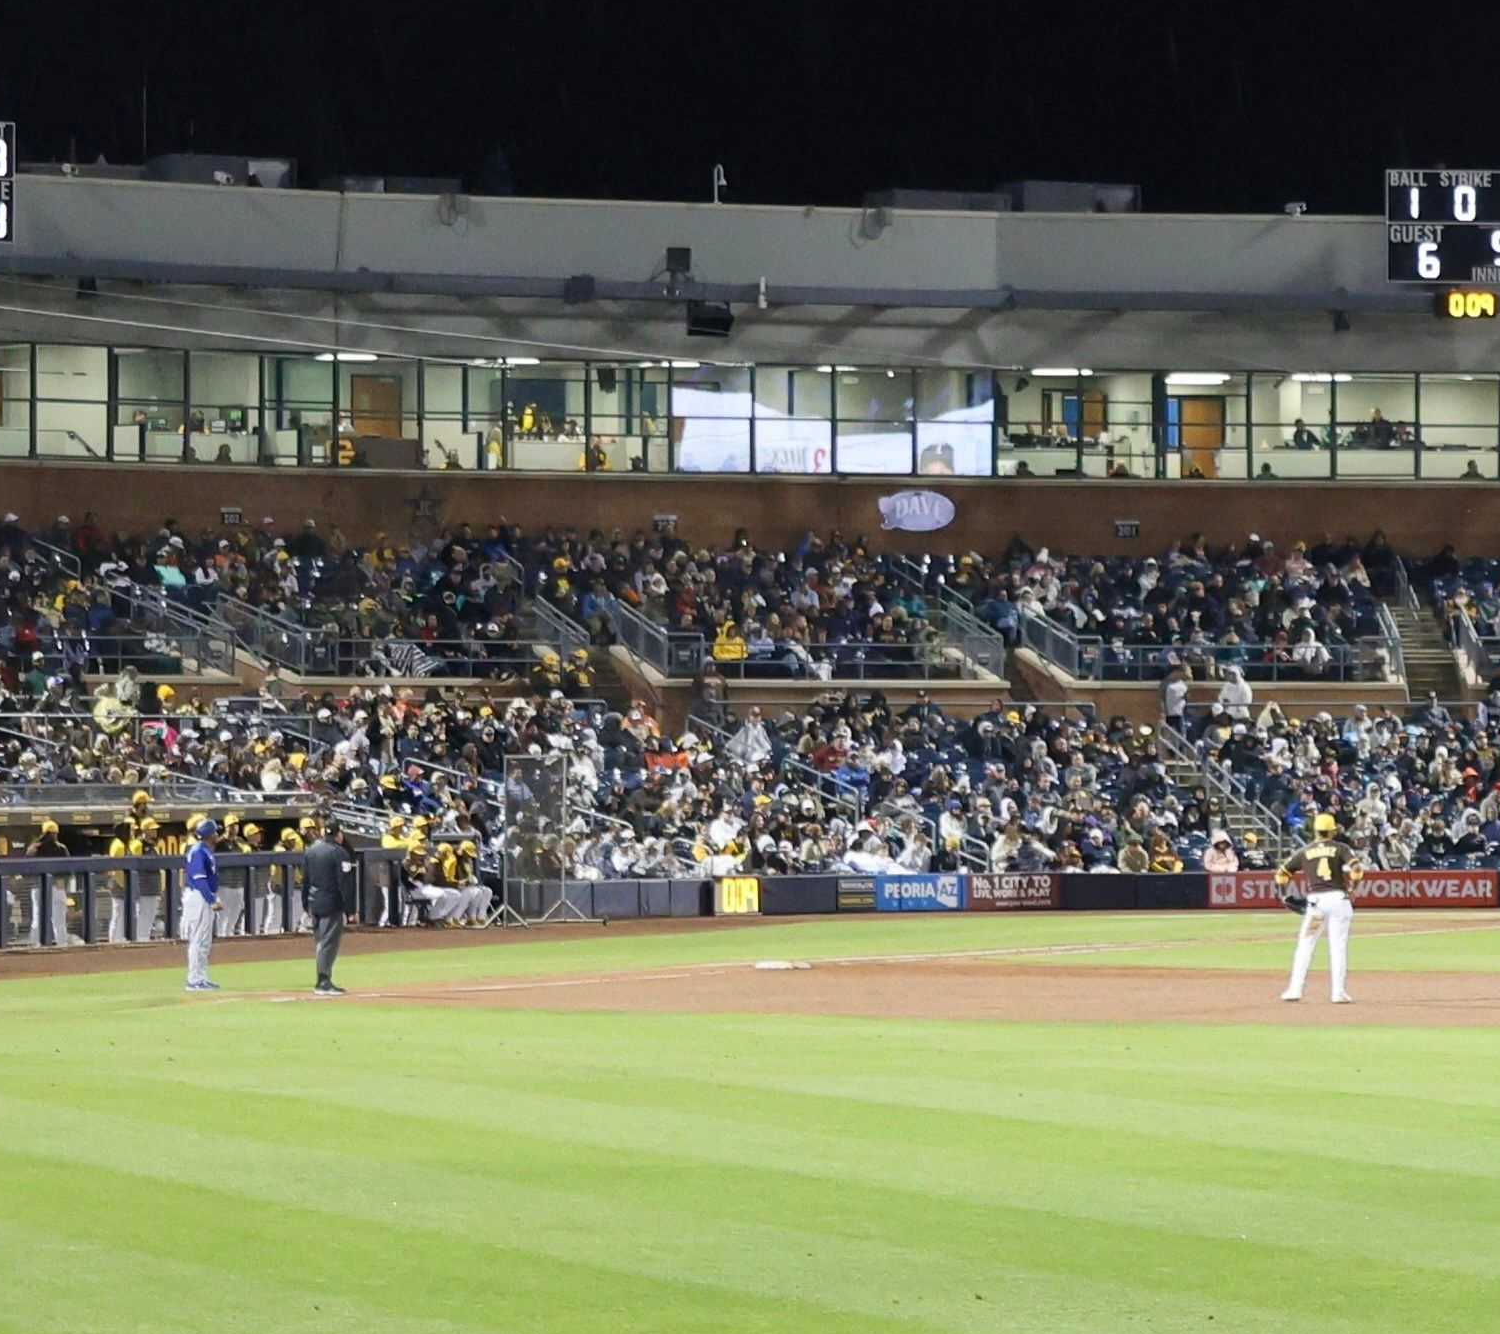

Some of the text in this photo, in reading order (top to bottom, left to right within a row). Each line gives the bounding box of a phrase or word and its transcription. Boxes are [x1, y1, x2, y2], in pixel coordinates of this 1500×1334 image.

[1390, 172, 1427, 187] BALL
[1439, 172, 1492, 188] STRIKE
[1410, 187, 1420, 219] 1
[1453, 186, 1476, 222] 0
[1390, 225, 1445, 243] GUEST
[1418, 242, 1441, 279] 6
[1316, 857, 1332, 881] 4
[884, 882, 935, 899] PEORIA
[1002, 876, 1029, 889] CITY
[1031, 875, 1052, 888] TO
[1354, 879, 1493, 899] WORKWEAR
[1027, 887, 1051, 897] PLAY
